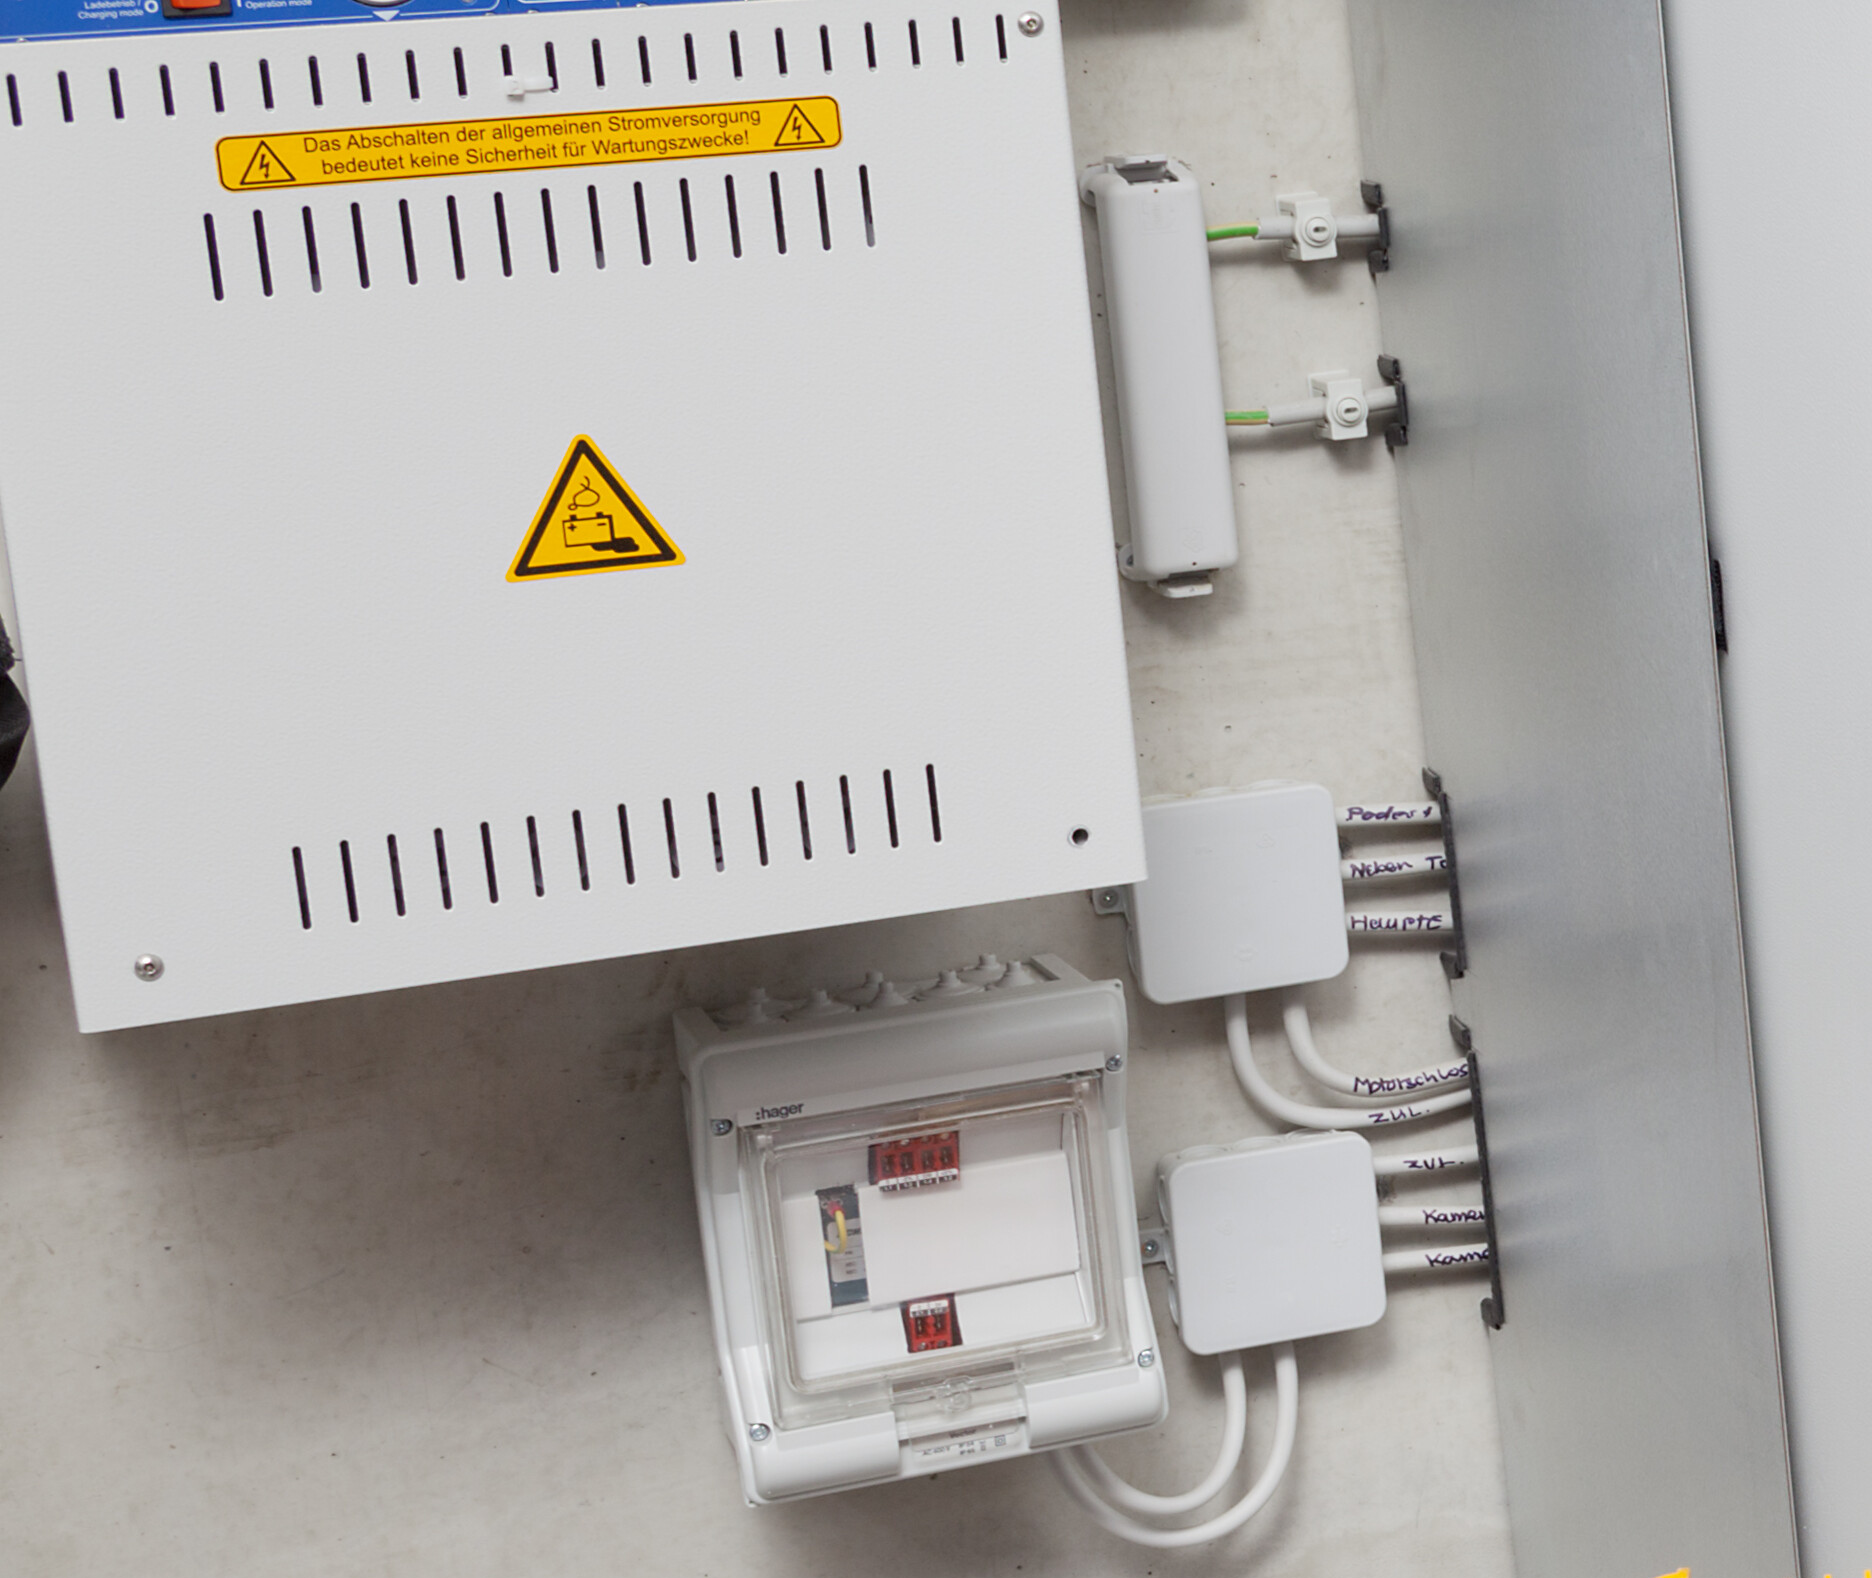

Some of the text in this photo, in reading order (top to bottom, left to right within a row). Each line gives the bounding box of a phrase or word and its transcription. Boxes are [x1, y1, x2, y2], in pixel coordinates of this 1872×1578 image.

[78, 11, 118, 19] Charging
[303, 109, 761, 153] Das Abschalten der allgemeinen Stromversorgung
[321, 130, 750, 175] bedeutet keine Sicherheit für Wartungszwecke!
